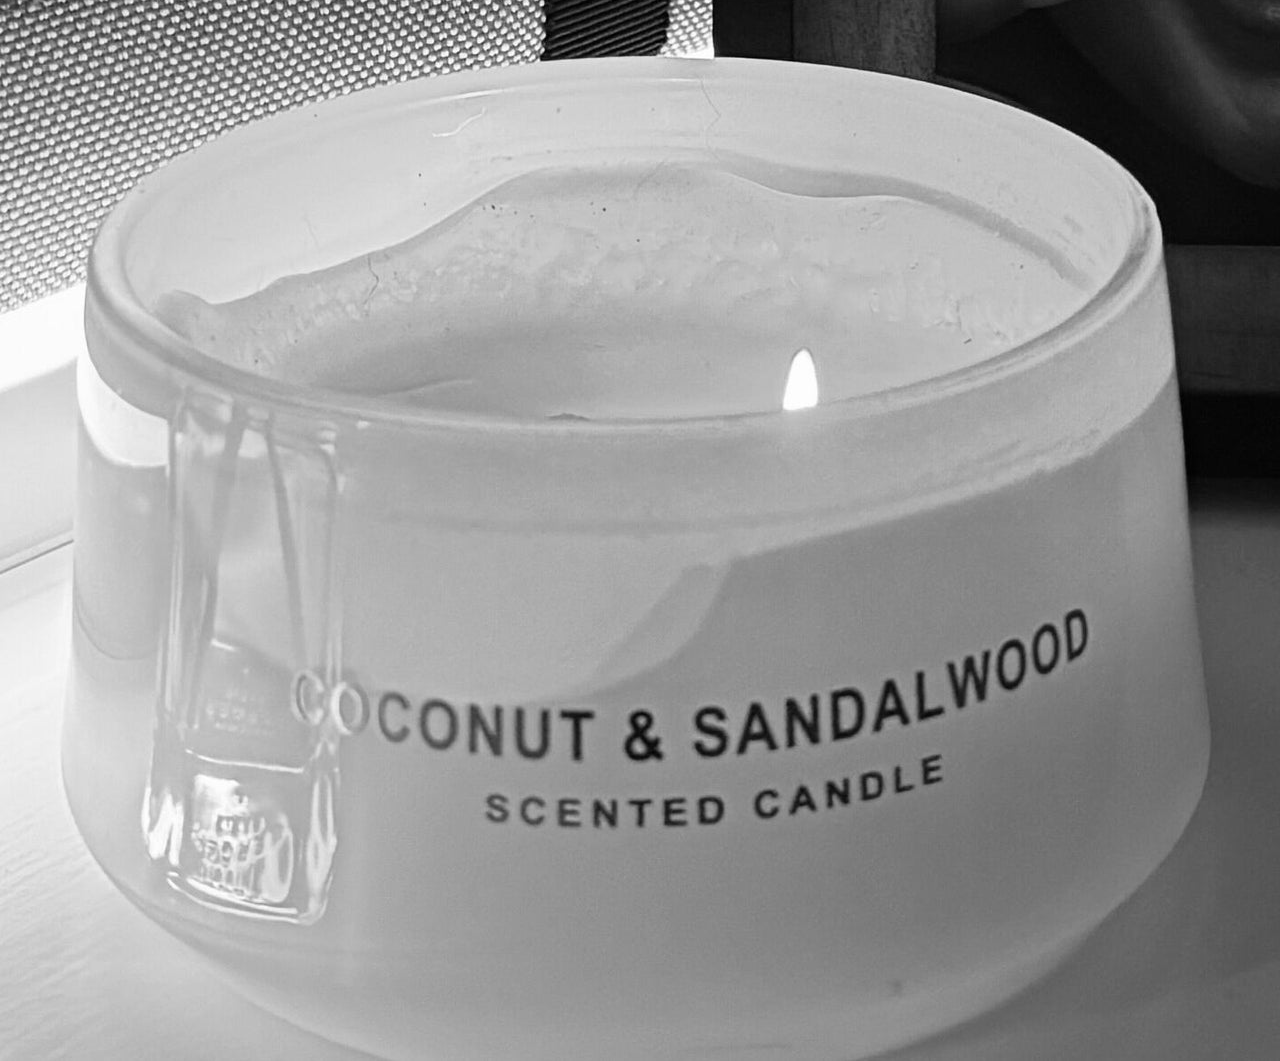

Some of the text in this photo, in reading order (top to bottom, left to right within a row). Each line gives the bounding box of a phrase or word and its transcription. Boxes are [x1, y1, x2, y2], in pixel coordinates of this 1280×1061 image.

[290, 667, 596, 762] COCONUT
[624, 708, 663, 762] &
[693, 608, 1089, 758] SANDALWOOD
[484, 753, 944, 828] SCENTED CANDLE
